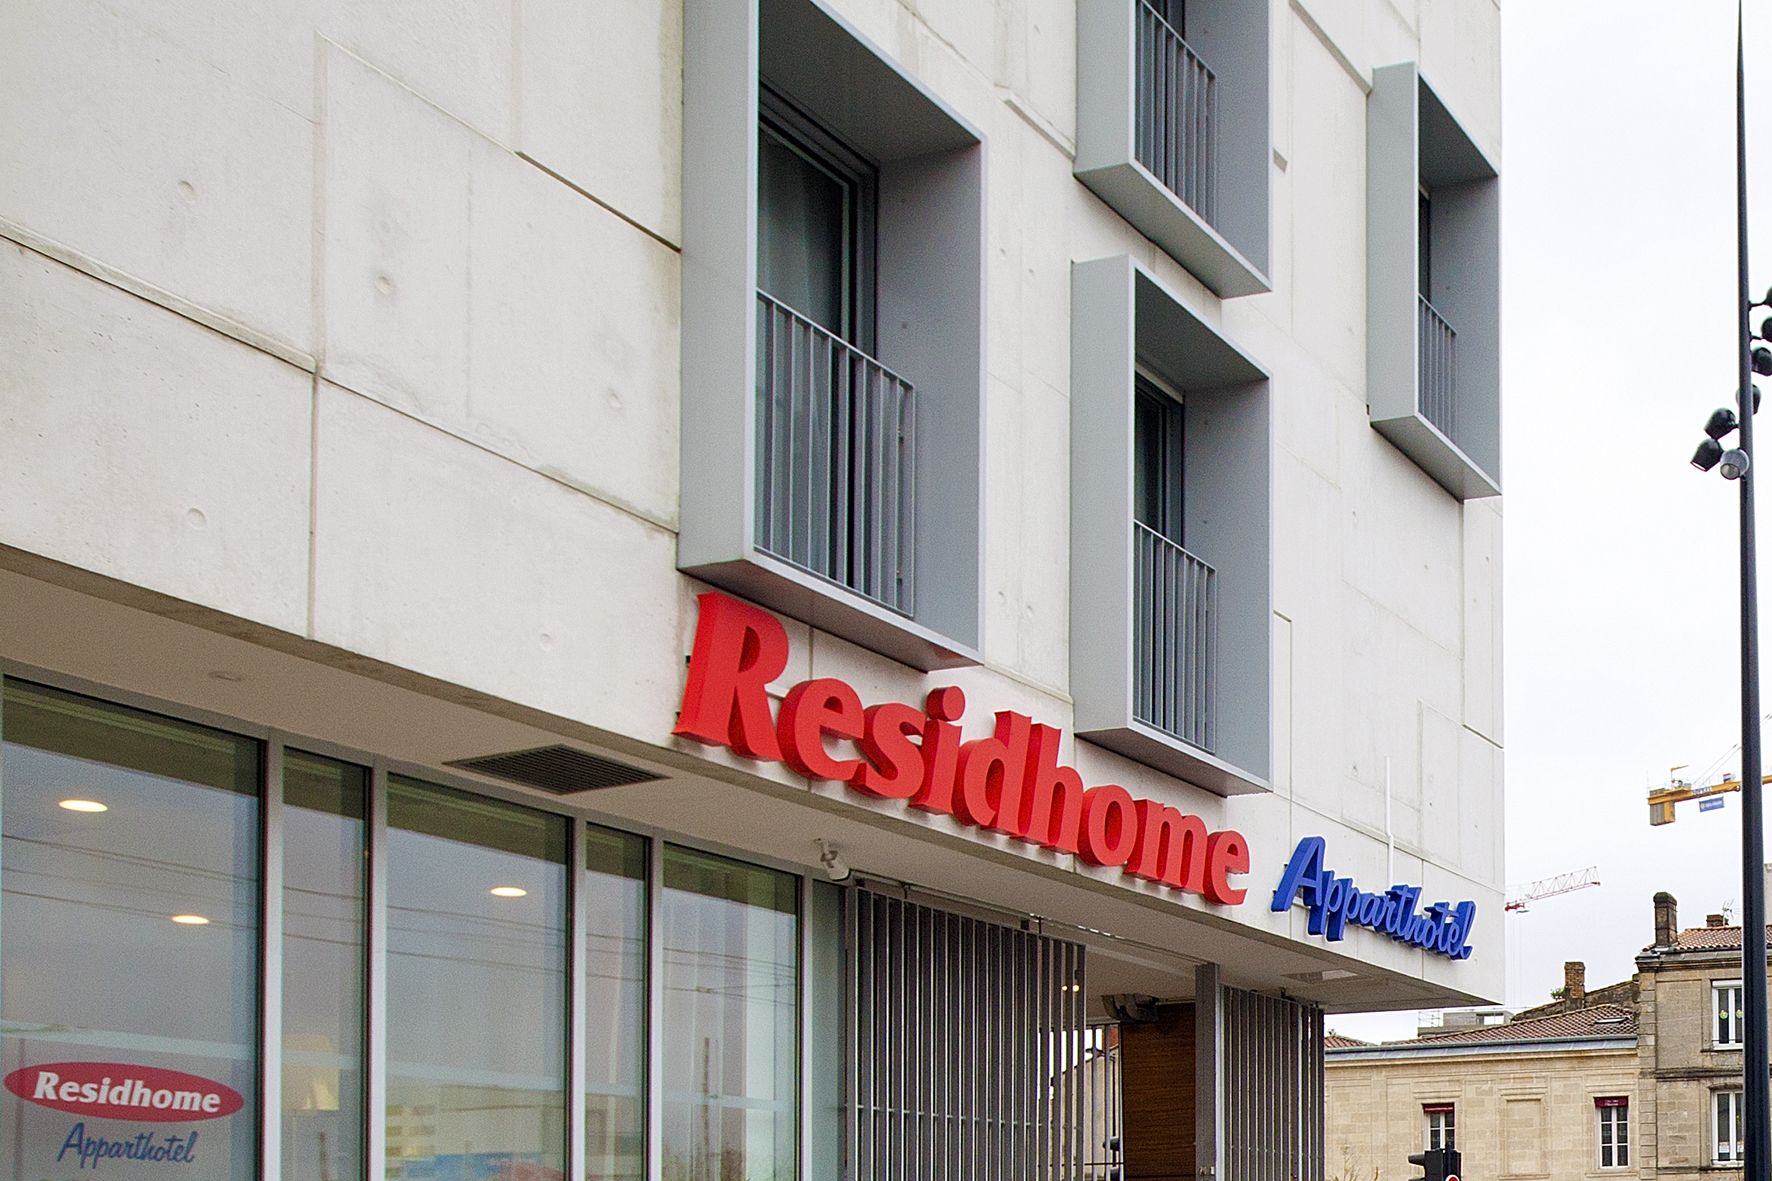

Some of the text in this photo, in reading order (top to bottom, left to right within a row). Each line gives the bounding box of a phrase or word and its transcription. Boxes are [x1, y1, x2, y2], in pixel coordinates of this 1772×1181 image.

[672, 591, 1250, 905] Residhome
[1271, 836, 1476, 961] Apparthotel
[33, 1071, 221, 1113] Residhome
[56, 1121, 199, 1169] Apparthotel
